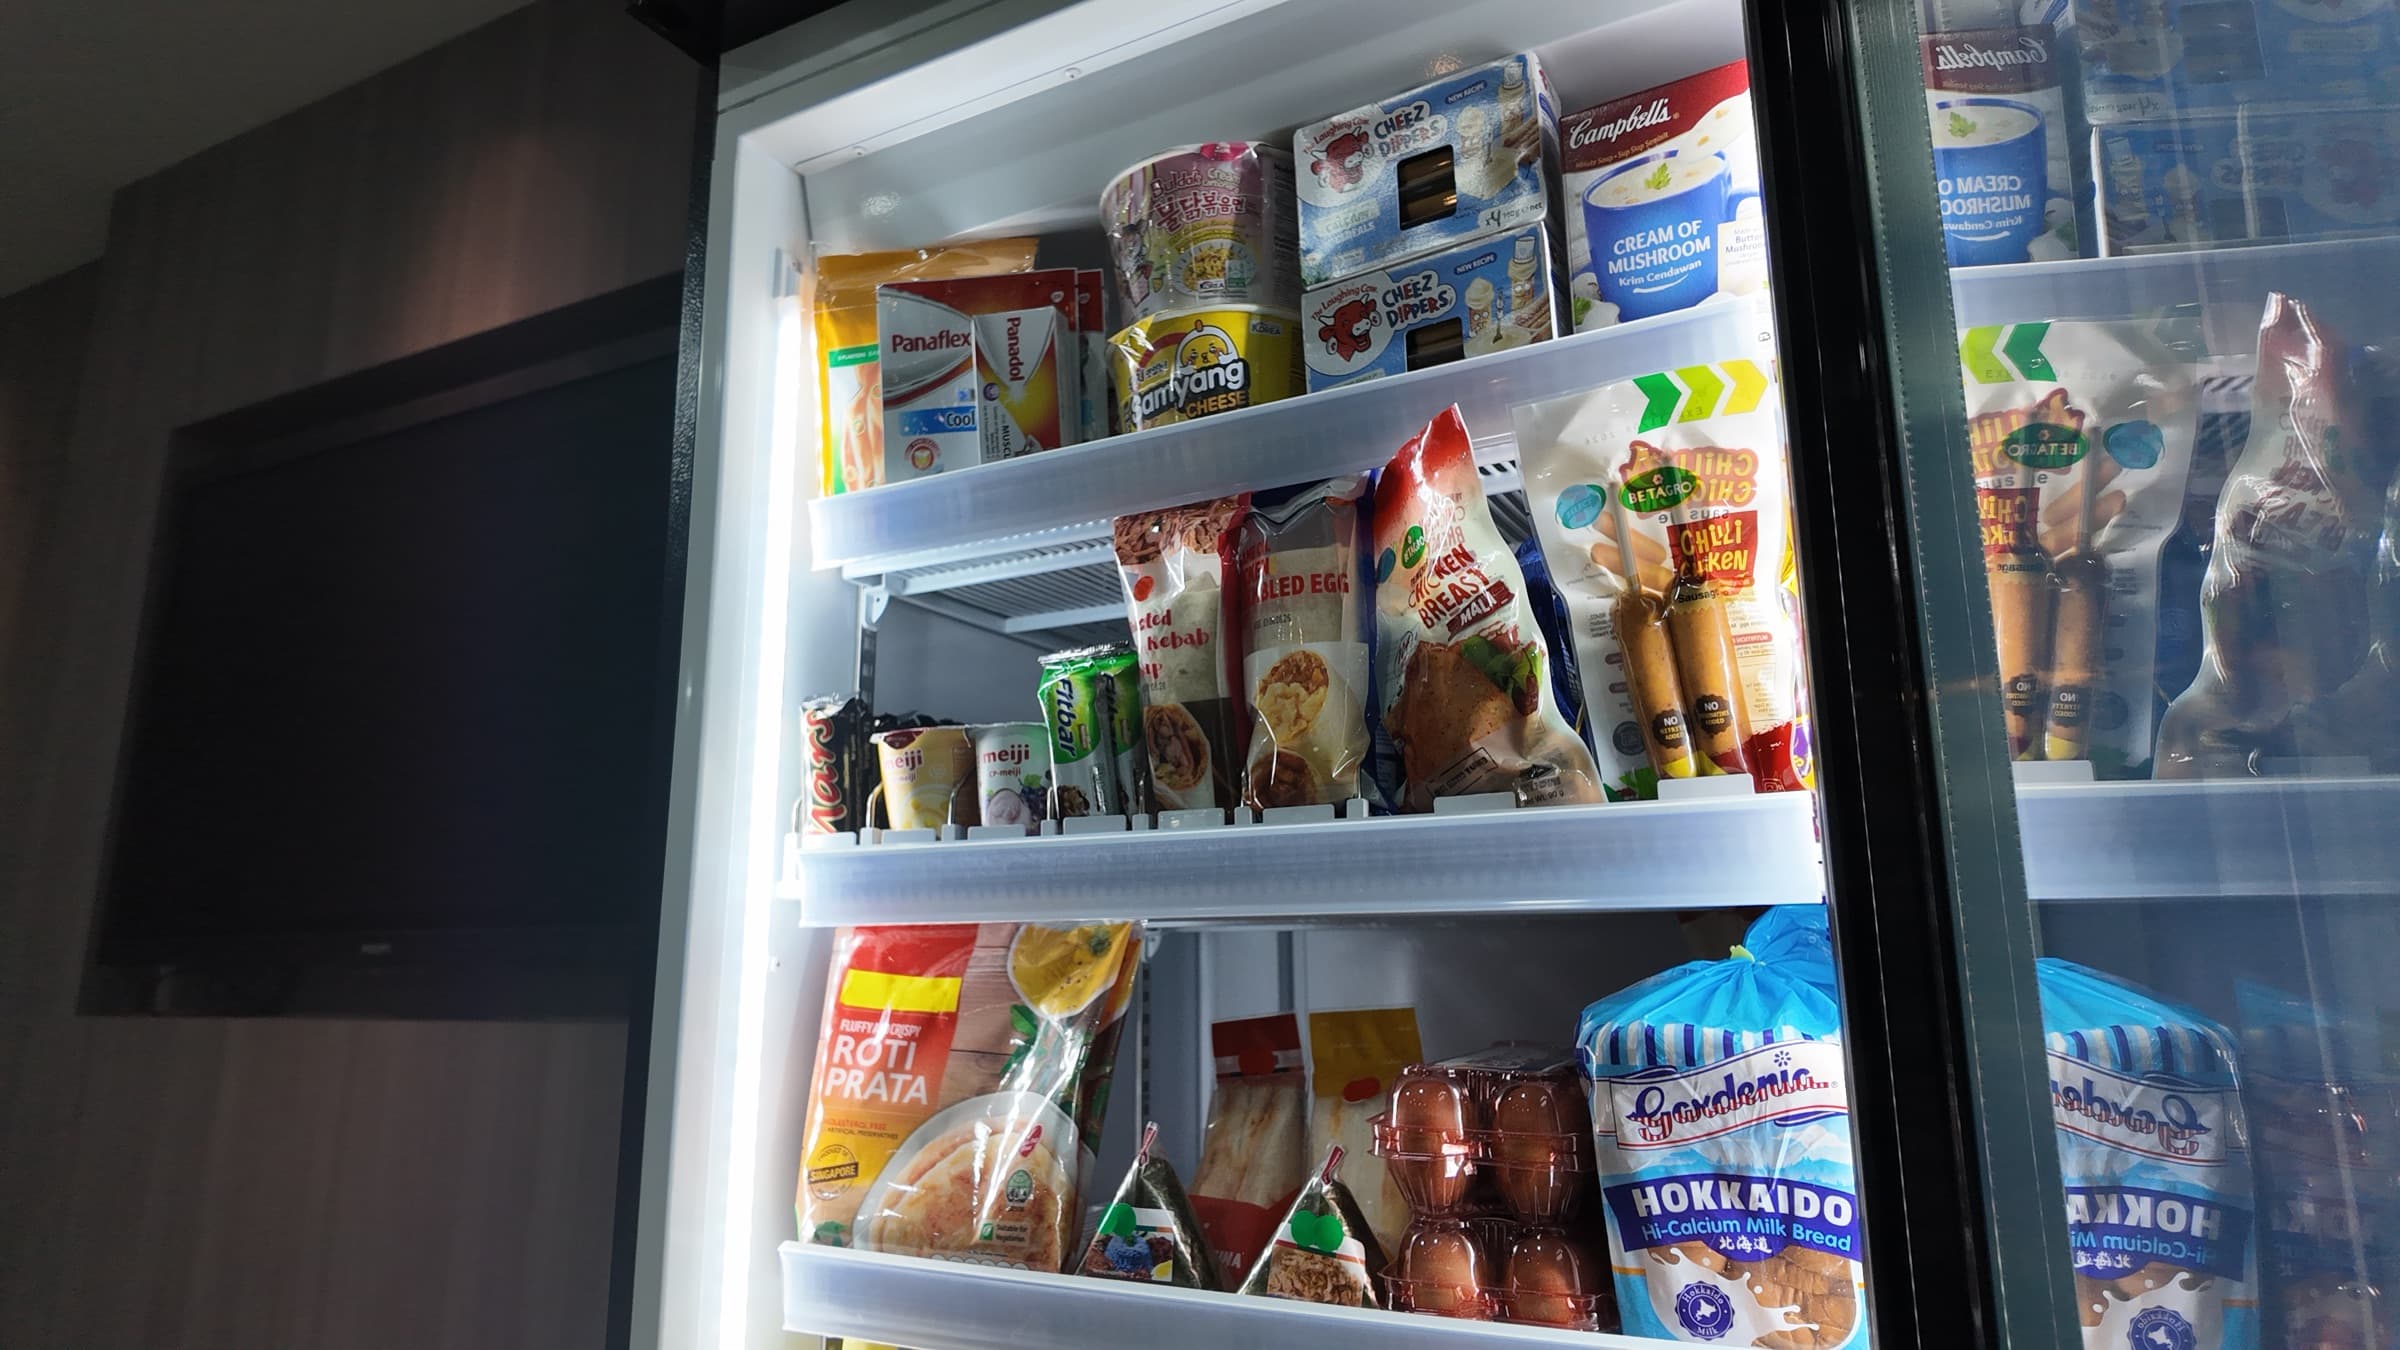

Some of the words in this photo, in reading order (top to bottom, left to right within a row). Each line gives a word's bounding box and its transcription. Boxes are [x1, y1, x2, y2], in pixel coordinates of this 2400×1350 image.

[1313, 119, 1353, 144] Laughing
[1374, 104, 1425, 139] CHEEZ
[1570, 98, 1671, 149] Campbell's
[1614, 224, 1674, 256] CREAM
[1678, 219, 1703, 237] OF
[1456, 262, 1473, 275] NEW
[1472, 253, 1496, 269] RECIPE
[1608, 235, 1711, 275] MUSHROOM
[1618, 271, 1645, 288] Krim
[1647, 259, 1703, 283] Cendawan
[1311, 307, 1324, 321] The
[1321, 286, 1361, 312] Laughing
[1382, 274, 1433, 308] CHEEZ
[1386, 289, 1449, 328] DIPPERS
[891, 330, 972, 354] Panaflex
[1006, 316, 1025, 382] Panadol
[946, 410, 976, 427] Cool
[1186, 391, 1248, 418] CHEESE
[1002, 424, 1012, 460] MUSCL
[1628, 480, 1694, 505] BETAGRO
[1310, 572, 1350, 594] EGG
[1408, 543, 1475, 609] CHICKEN
[1419, 567, 1490, 629] BREAST
[1704, 701, 1719, 712] NO
[1664, 716, 1678, 727] NO
[885, 749, 923, 769] meiji
[983, 744, 1030, 765] meiji
[988, 766, 1021, 779] CP-meiji
[840, 1018, 875, 1035] FLUFFY
[890, 1022, 920, 1038] CRISPY
[832, 1035, 918, 1071] ROTI
[825, 1067, 929, 1106] PRATA
[1626, 1067, 1830, 1142] Gardenia
[811, 1165, 857, 1181] SINGAPORE
[1631, 1179, 1853, 1227] HOKKAIDO
[1641, 1216, 1740, 1242] Hi-Calcium
[1747, 1217, 1787, 1238] Milk
[1792, 1222, 1852, 1252] Bread
[1719, 1235, 1773, 1255] 北海道
[1683, 1284, 1725, 1306] Hokkaido
[1697, 1324, 1718, 1337] Milk
